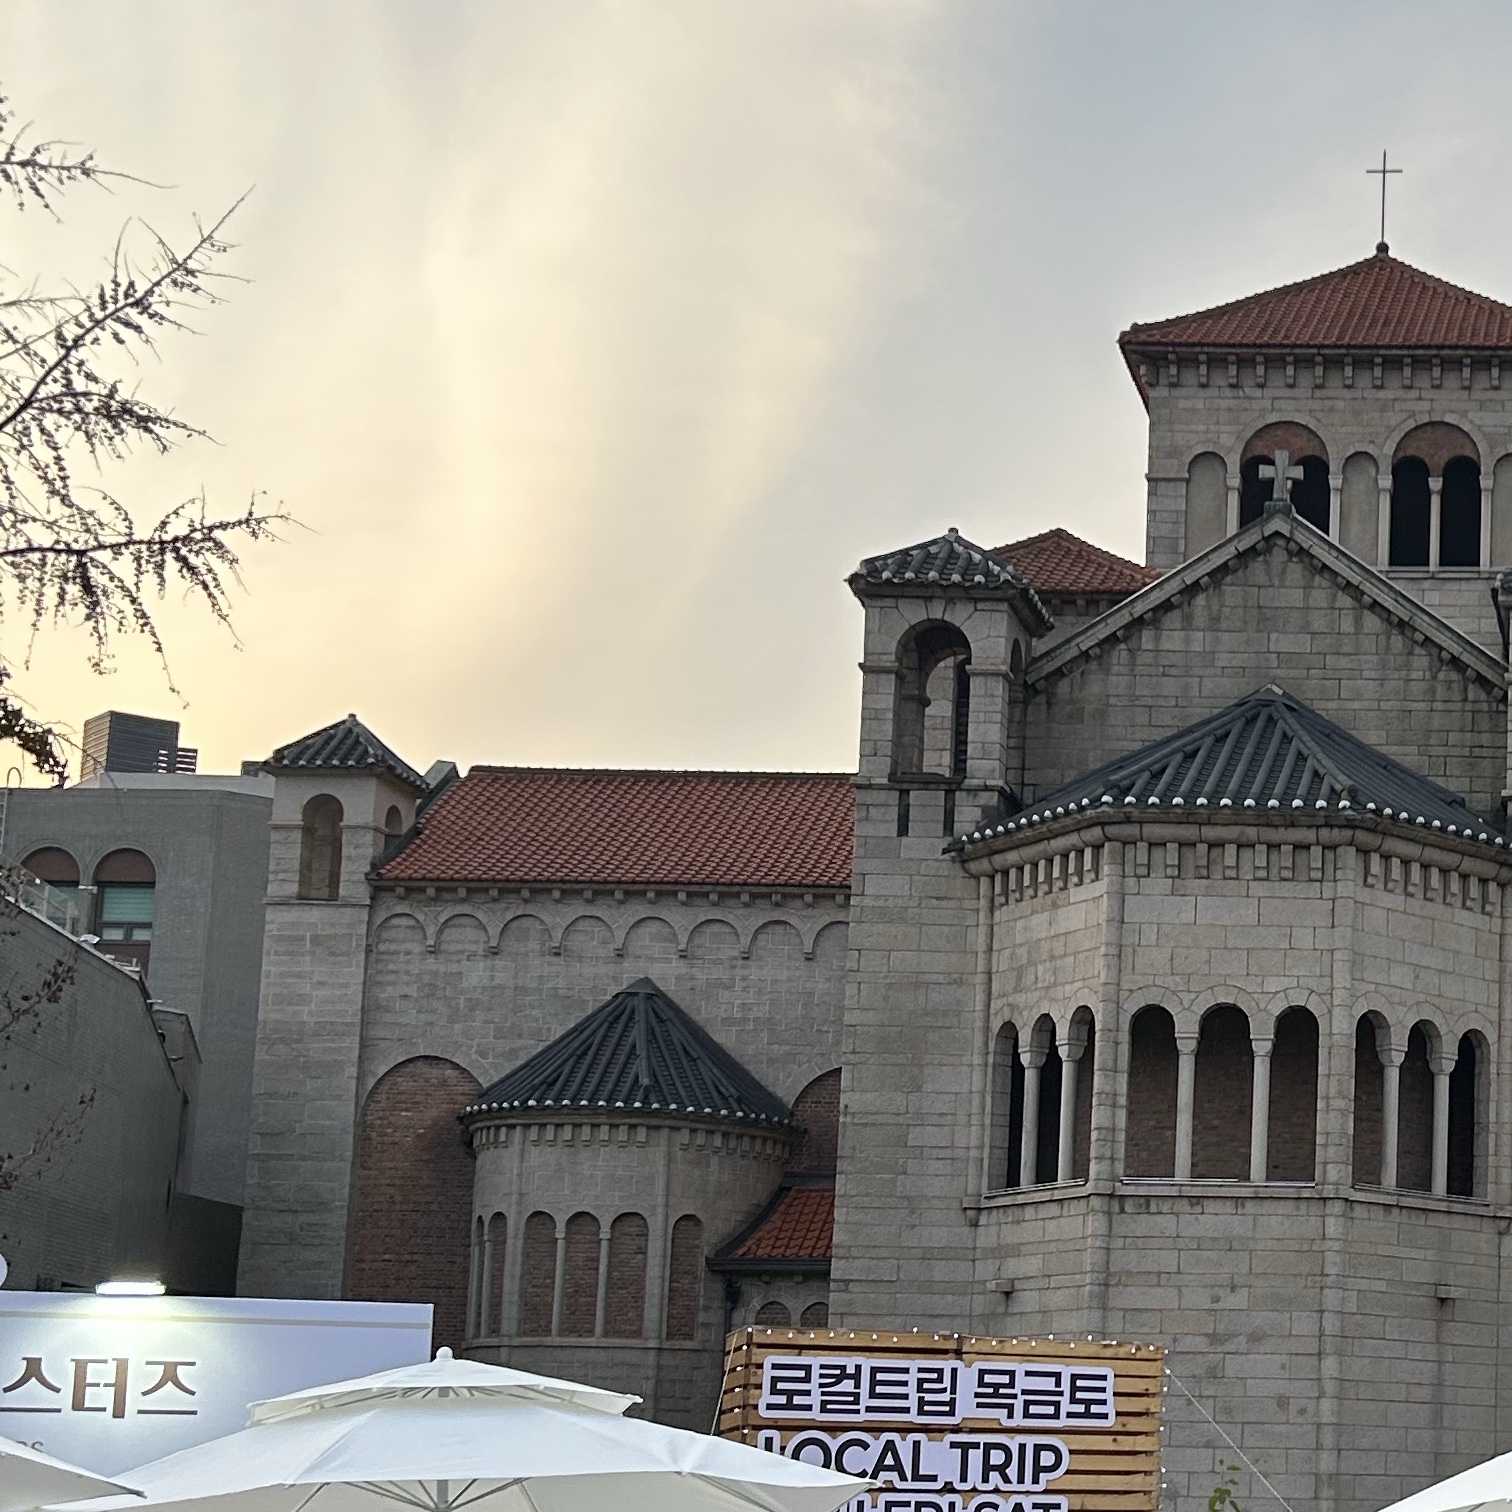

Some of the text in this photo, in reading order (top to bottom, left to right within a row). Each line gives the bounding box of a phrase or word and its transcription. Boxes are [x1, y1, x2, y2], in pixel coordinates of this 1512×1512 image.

[0, 1357, 198, 1419] 스터즈
[765, 1363, 1109, 1420] 로컬트립 목금토
[950, 1441, 1063, 1485] TRIP
